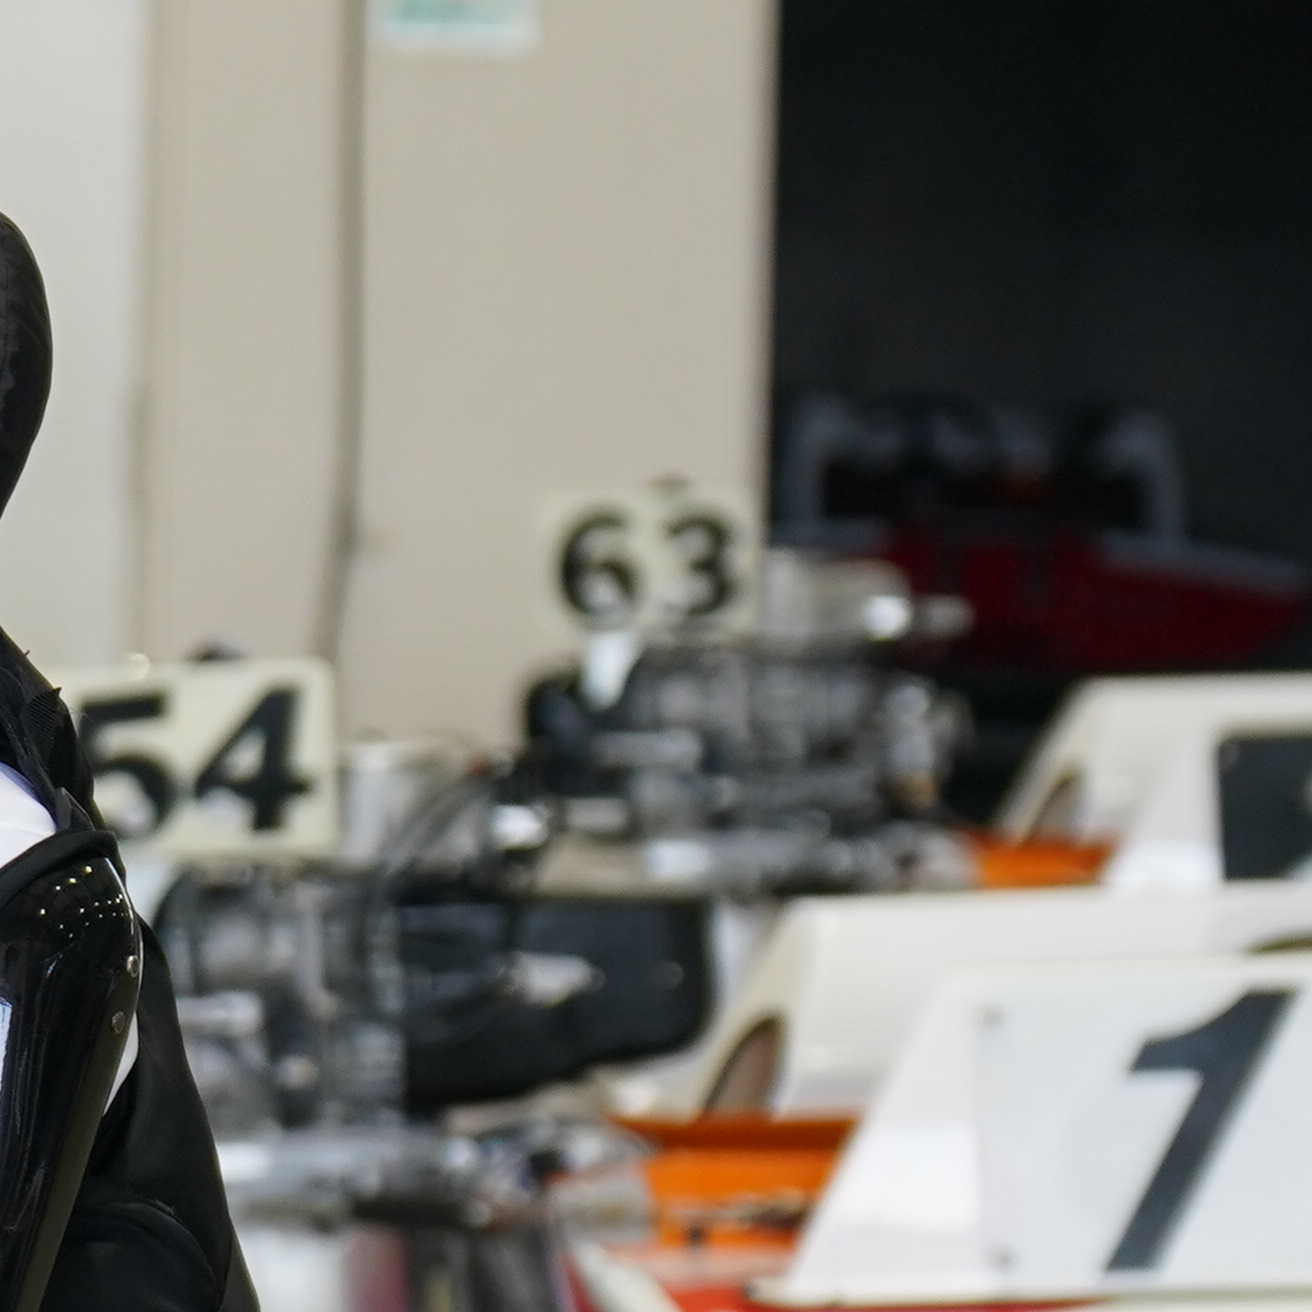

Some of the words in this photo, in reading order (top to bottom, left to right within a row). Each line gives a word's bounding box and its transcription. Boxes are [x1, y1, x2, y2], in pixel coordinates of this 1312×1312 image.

[557, 506, 737, 620] 63
[78, 685, 311, 838] 54
[1104, 989, 1299, 1275] 1
